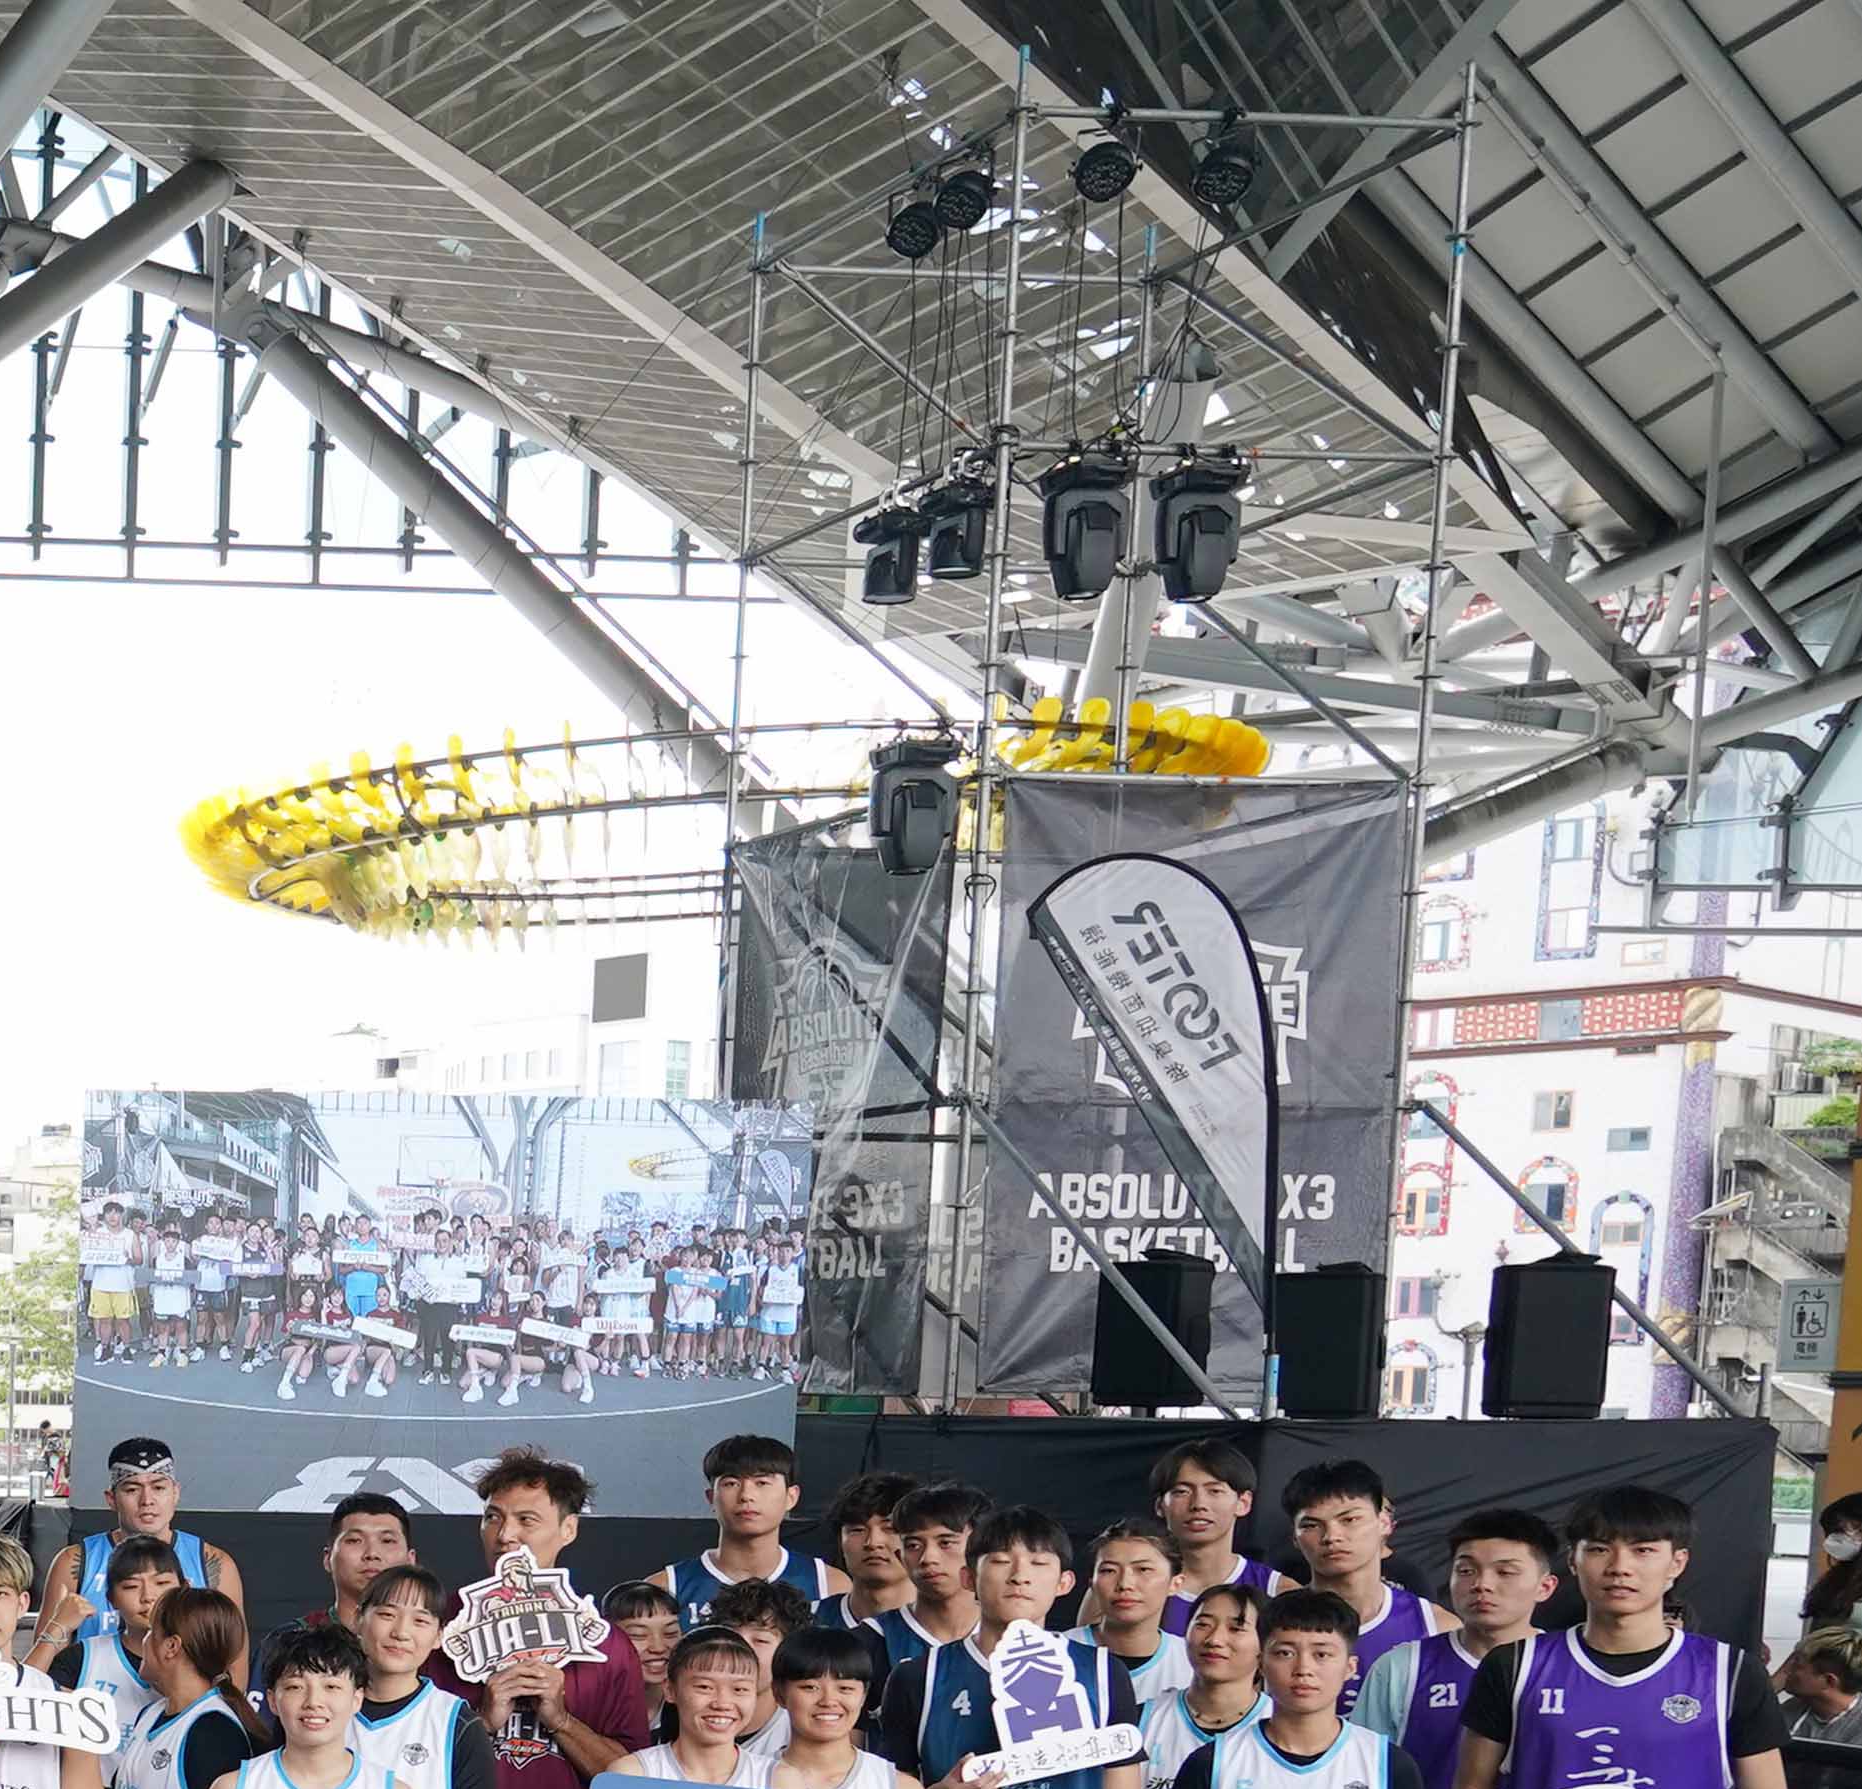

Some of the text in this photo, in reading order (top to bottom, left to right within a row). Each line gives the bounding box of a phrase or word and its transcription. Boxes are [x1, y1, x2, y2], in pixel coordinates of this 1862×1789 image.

[462, 1611, 585, 1677] JIA-LI
[94, 1679, 118, 1696] 77
[1430, 1683, 1460, 1708] 21
[951, 1689, 972, 1716] 4
[1540, 1689, 1566, 1715] 11
